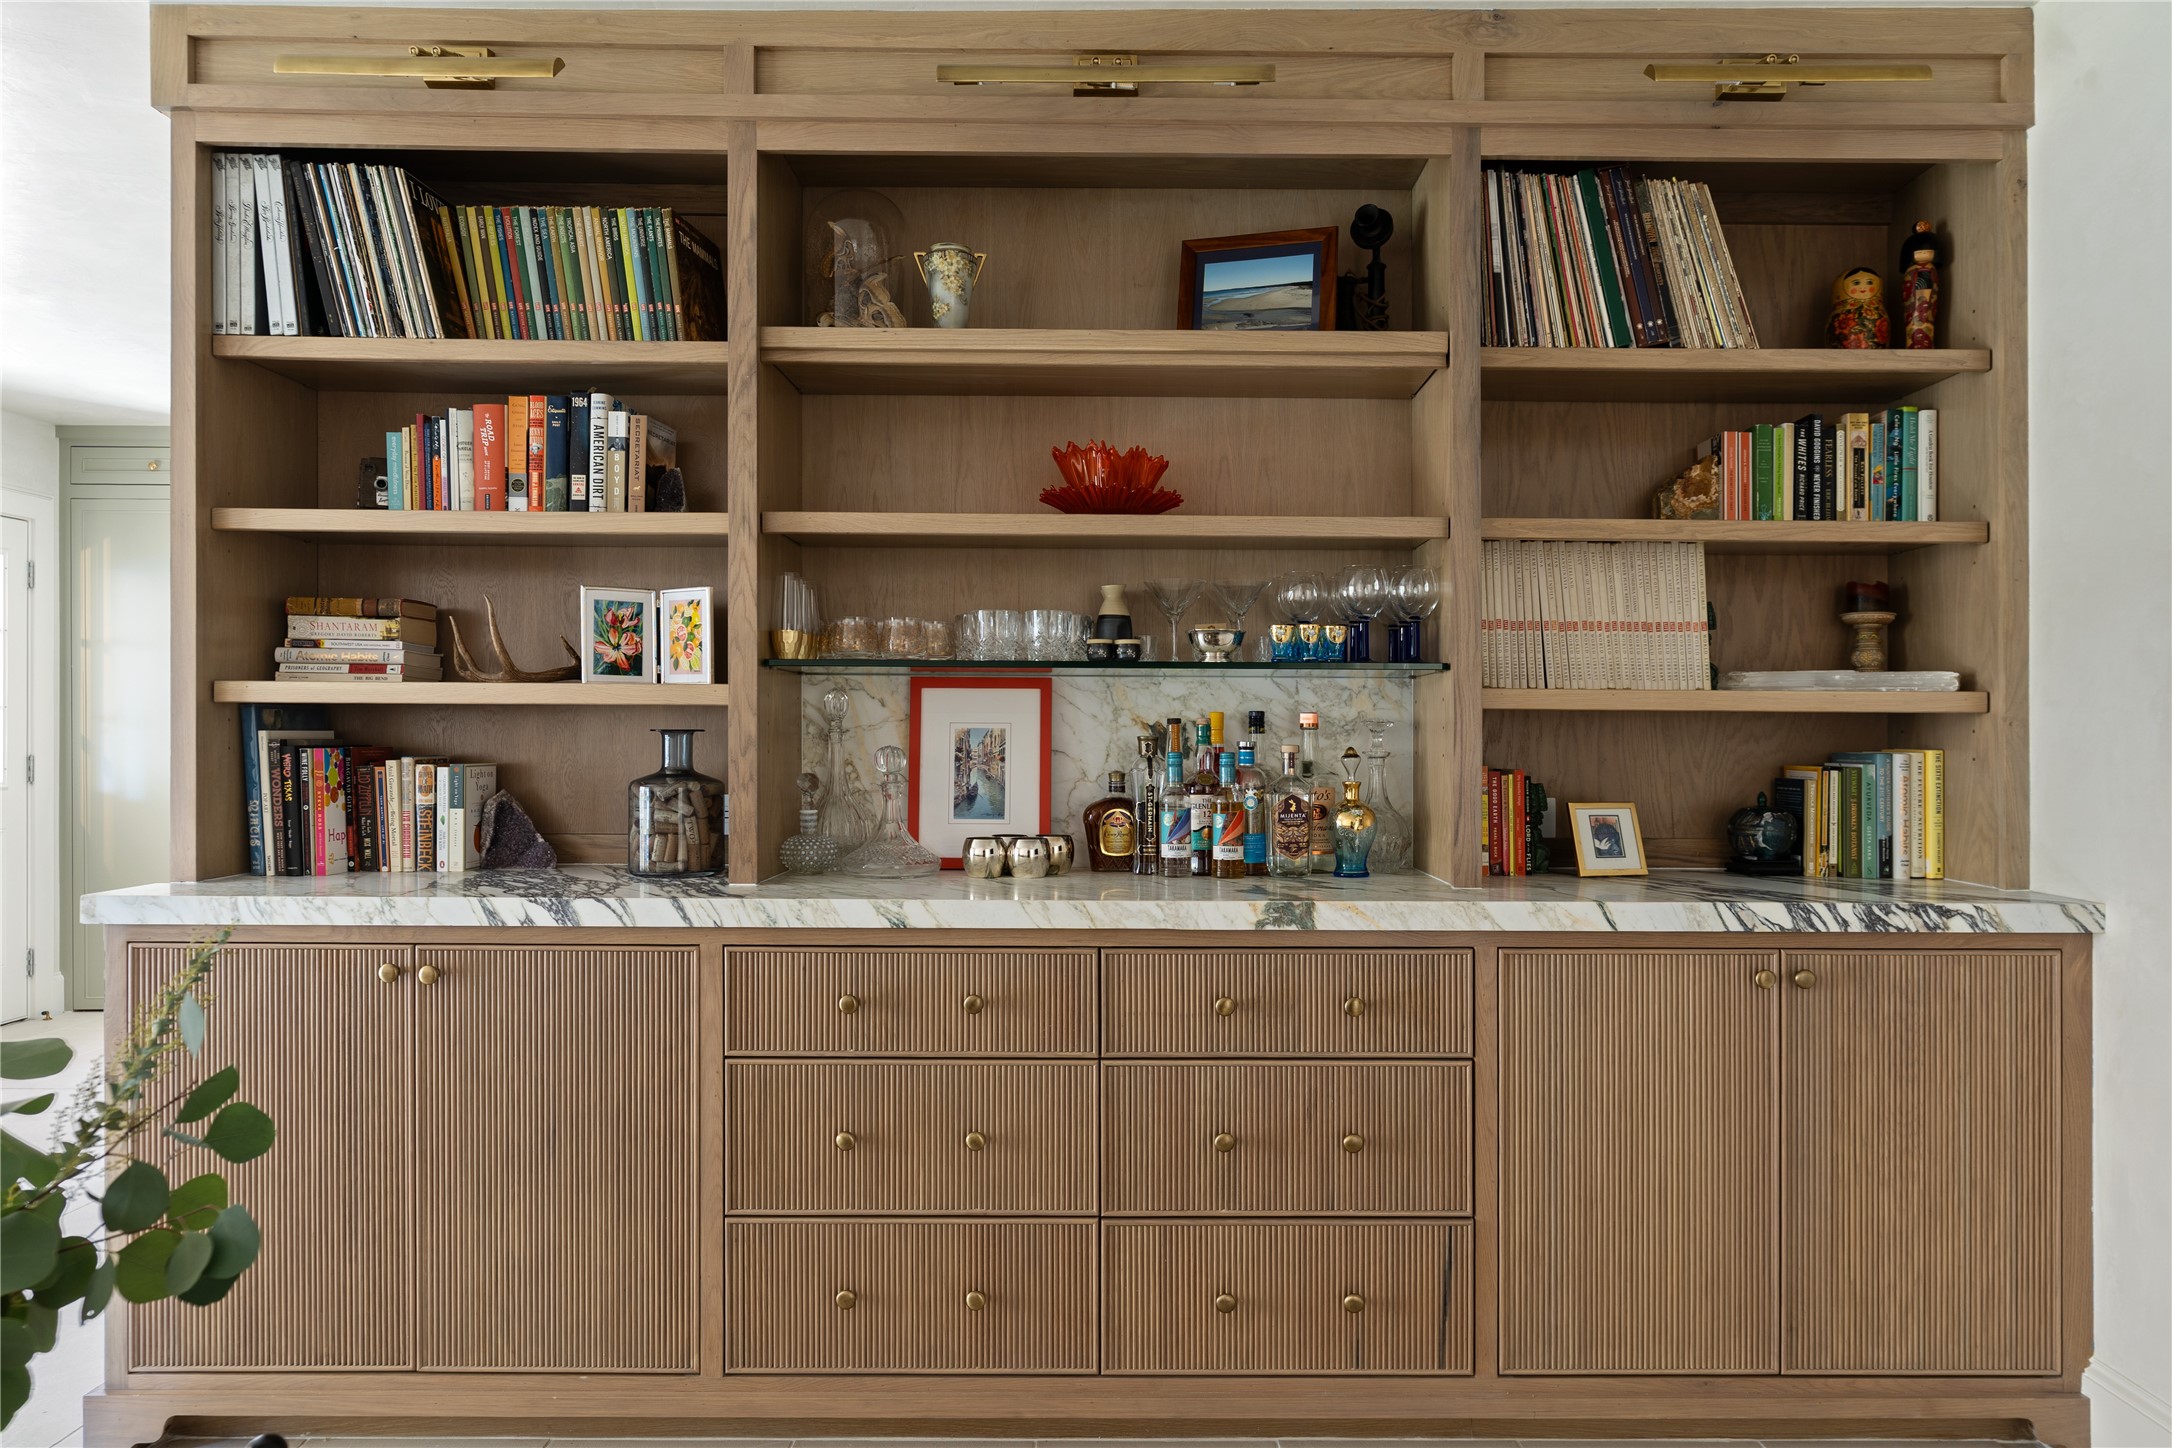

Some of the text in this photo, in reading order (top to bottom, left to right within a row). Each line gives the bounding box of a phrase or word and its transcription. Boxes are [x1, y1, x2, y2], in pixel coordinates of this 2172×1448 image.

[409, 180, 417, 200] I
[458, 215, 466, 237] ECOLOGY
[503, 215, 513, 240] EVOLUTION
[513, 226, 521, 246] FOREST
[565, 216, 574, 239] TROPICAL
[637, 226, 647, 247] UNIVERSE
[646, 225, 655, 242] PLANTS
[530, 216, 538, 233] INDEX
[535, 244, 543, 262] GUIDE
[601, 217, 613, 260] NORTH AMERICA
[655, 226, 664, 248] PRIMATES
[664, 228, 673, 249] MAMMALS
[678, 231, 691, 250] THE
[572, 397, 588, 407] 1964
[479, 427, 488, 445] TRIP
[484, 419, 494, 441] ROAD
[1892, 436, 1899, 445] Ng
[1908, 435, 1915, 445] Me
[390, 436, 399, 460] everyday
[1797, 438, 1807, 470] WHITES
[1824, 439, 1832, 477] FEARLESS
[1906, 446, 1916, 464] Tight
[593, 425, 604, 499] AMERICAN DIRT
[309, 621, 378, 631] SHANTARAM
[296, 651, 378, 661] Atomic Habits
[470, 769, 486, 779] Light
[271, 767, 283, 827] WONDERS
[283, 778, 292, 801] TEXAS
[357, 768, 371, 816] LED ZEPPELIN
[475, 782, 489, 792] Yoga
[388, 810, 396, 825] Being
[1900, 775, 1909, 855] Atomic Habits
[419, 810, 432, 872] STEINBECK
[363, 848, 371, 859] WALL
